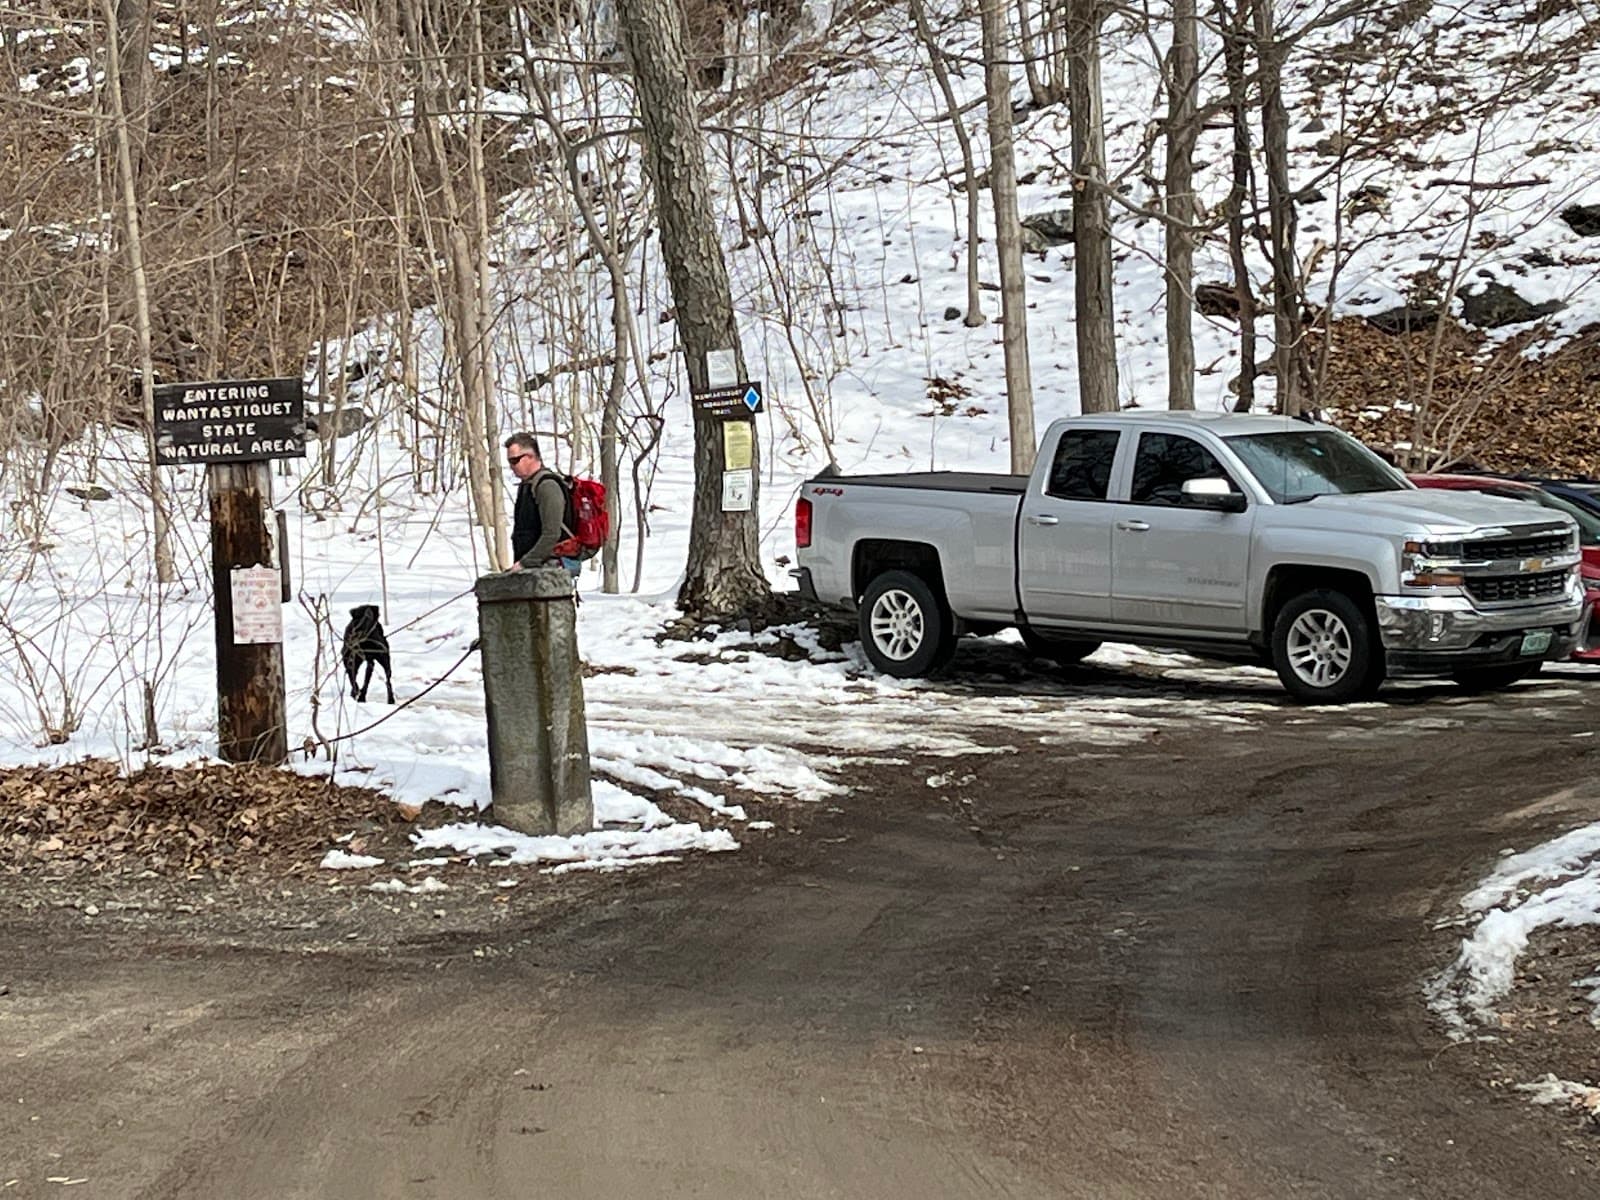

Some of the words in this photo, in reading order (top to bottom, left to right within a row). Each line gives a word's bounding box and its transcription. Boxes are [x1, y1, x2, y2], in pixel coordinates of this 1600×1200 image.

[183, 385, 269, 403] ENTERING
[162, 402, 292, 421] WANTASTIQUET
[202, 422, 256, 437] STATE
[164, 442, 243, 458] NATURAL
[251, 439, 295, 454] AREA
